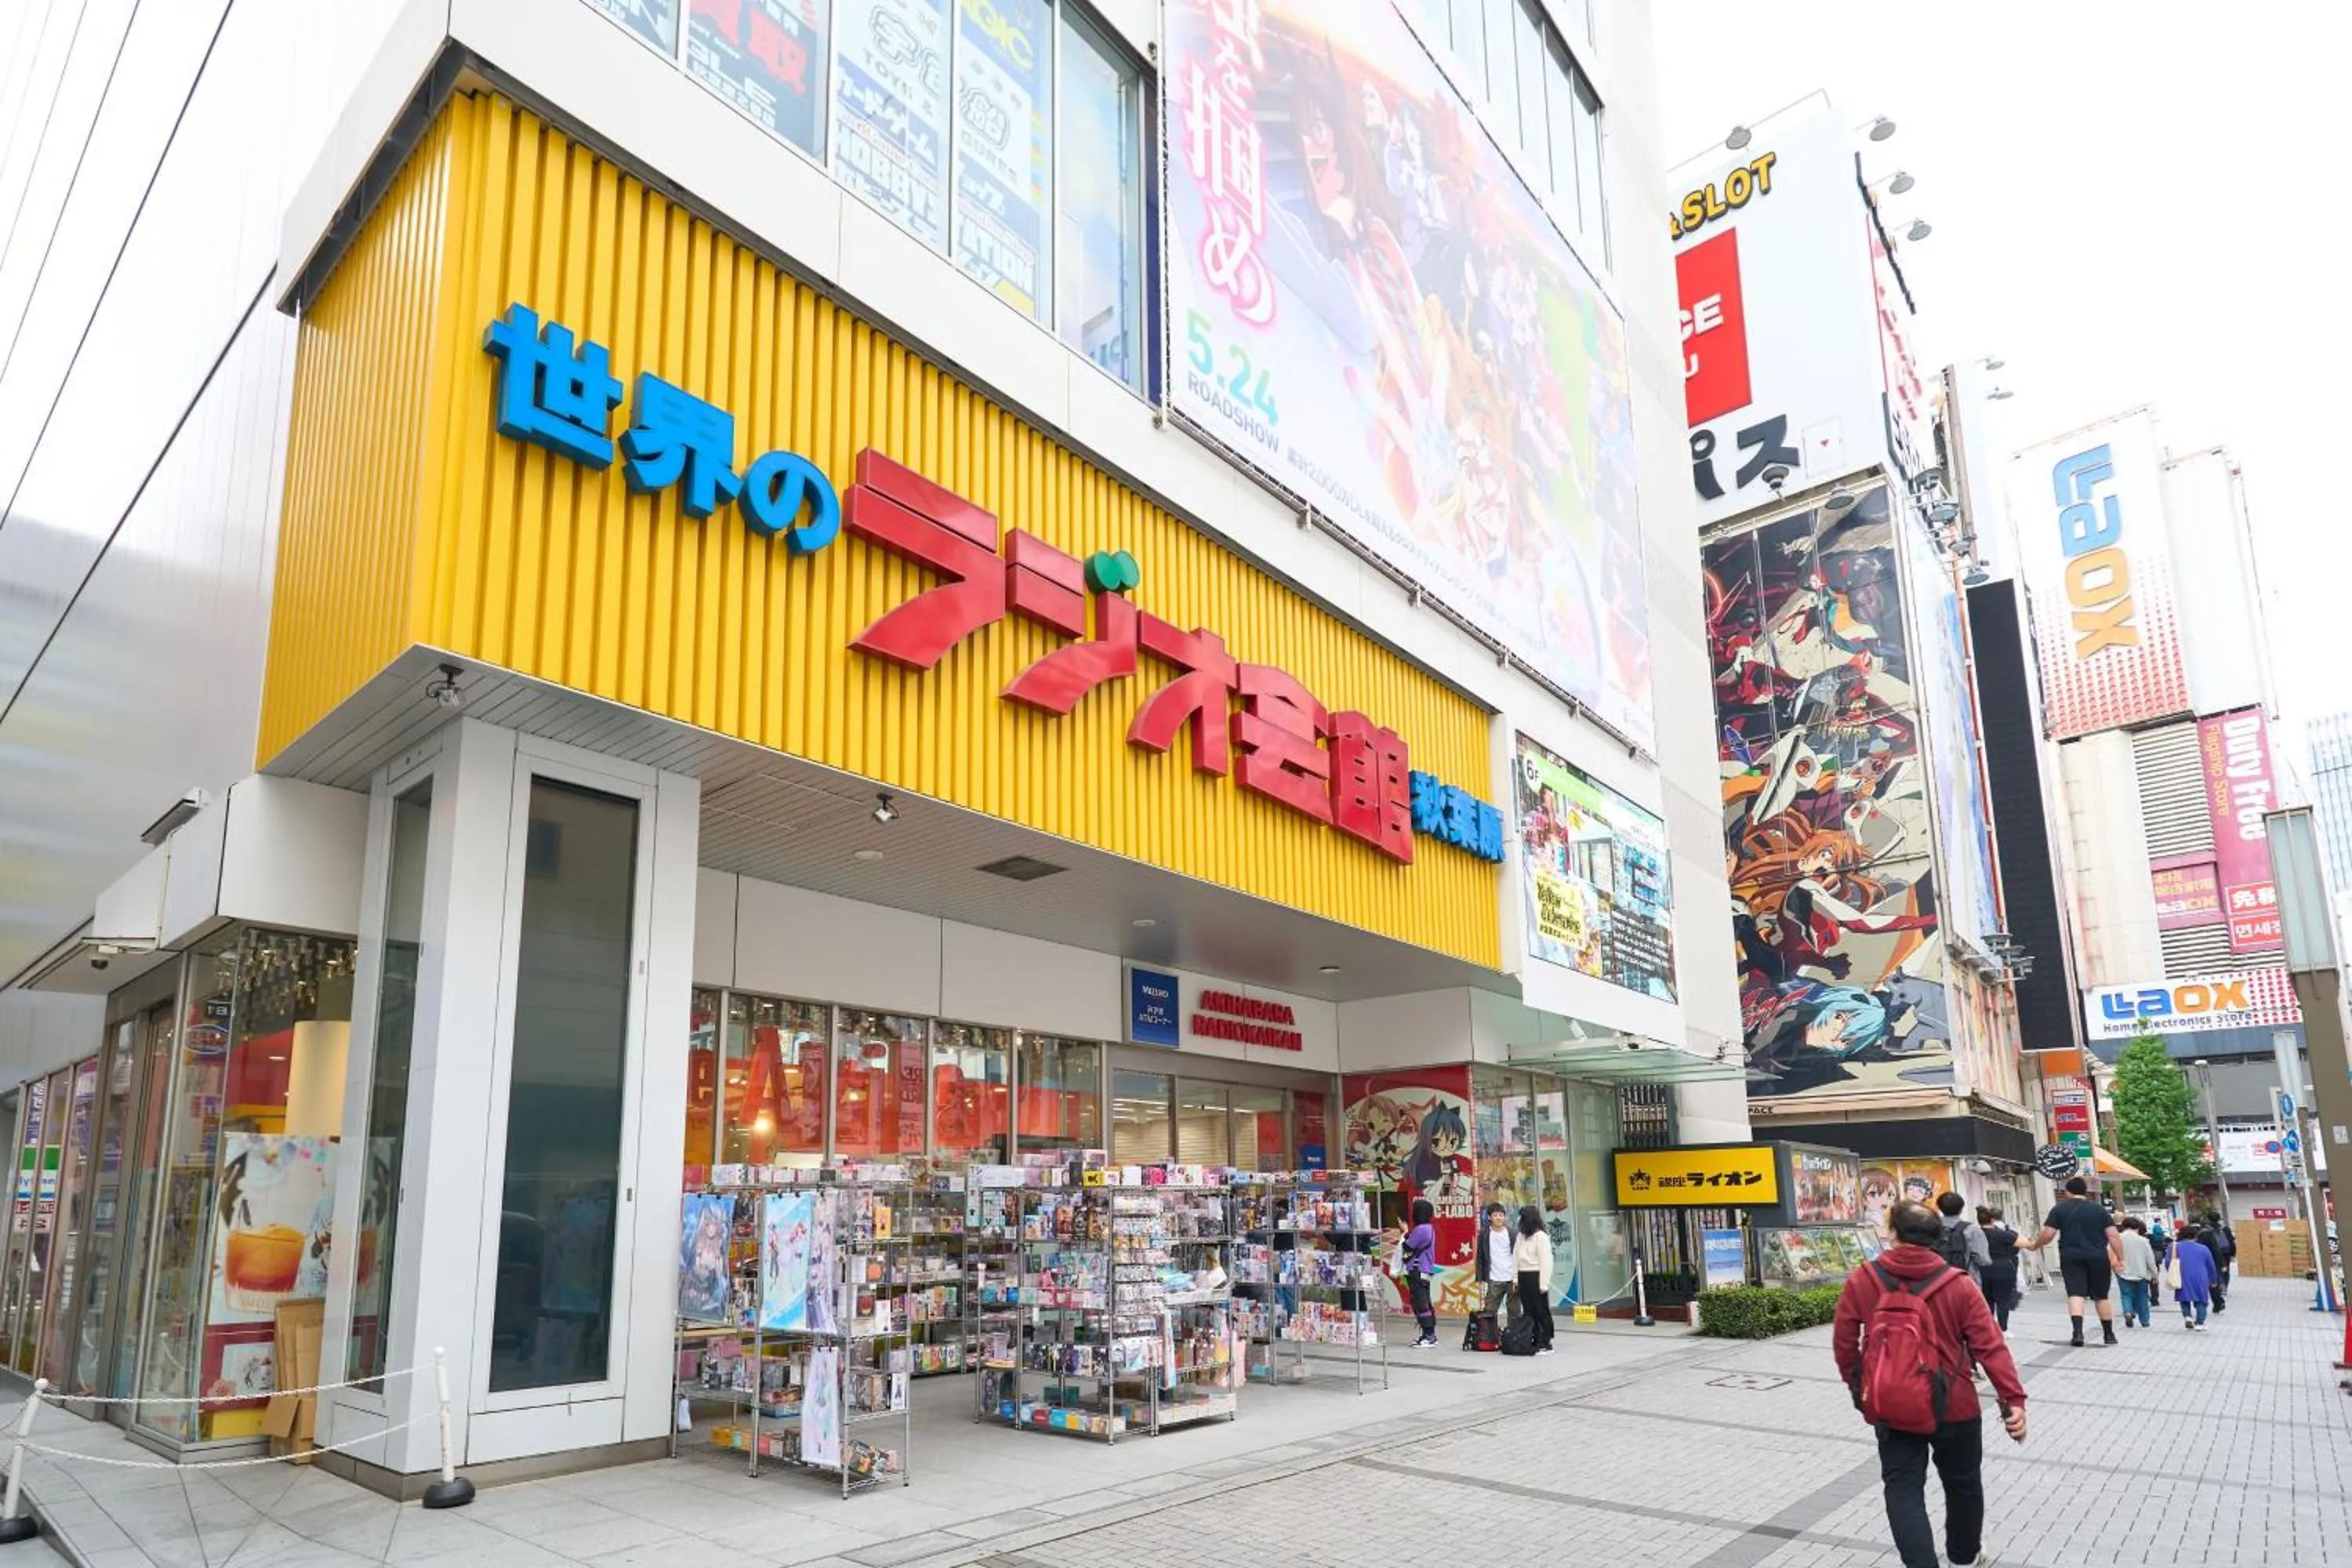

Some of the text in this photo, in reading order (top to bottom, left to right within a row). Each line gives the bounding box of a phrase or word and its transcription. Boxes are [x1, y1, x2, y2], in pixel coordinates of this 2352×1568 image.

[1186, 309, 1279, 427] 5.24
[1187, 372, 1279, 455] ROADSHOW
[483, 302, 841, 557] 世界の
[844, 446, 1414, 866] ラジオ会館
[1408, 768, 1505, 864] 秋葉原
[2205, 724, 2230, 816] Flagship Store
[2223, 716, 2271, 841] Duty Free
[1200, 989, 1296, 1025] AKIHABARA
[2103, 1023, 2139, 1033] Home
[2216, 1011, 2252, 1025] Store
[1658, 1170, 1763, 1188] 銀座ライオン
